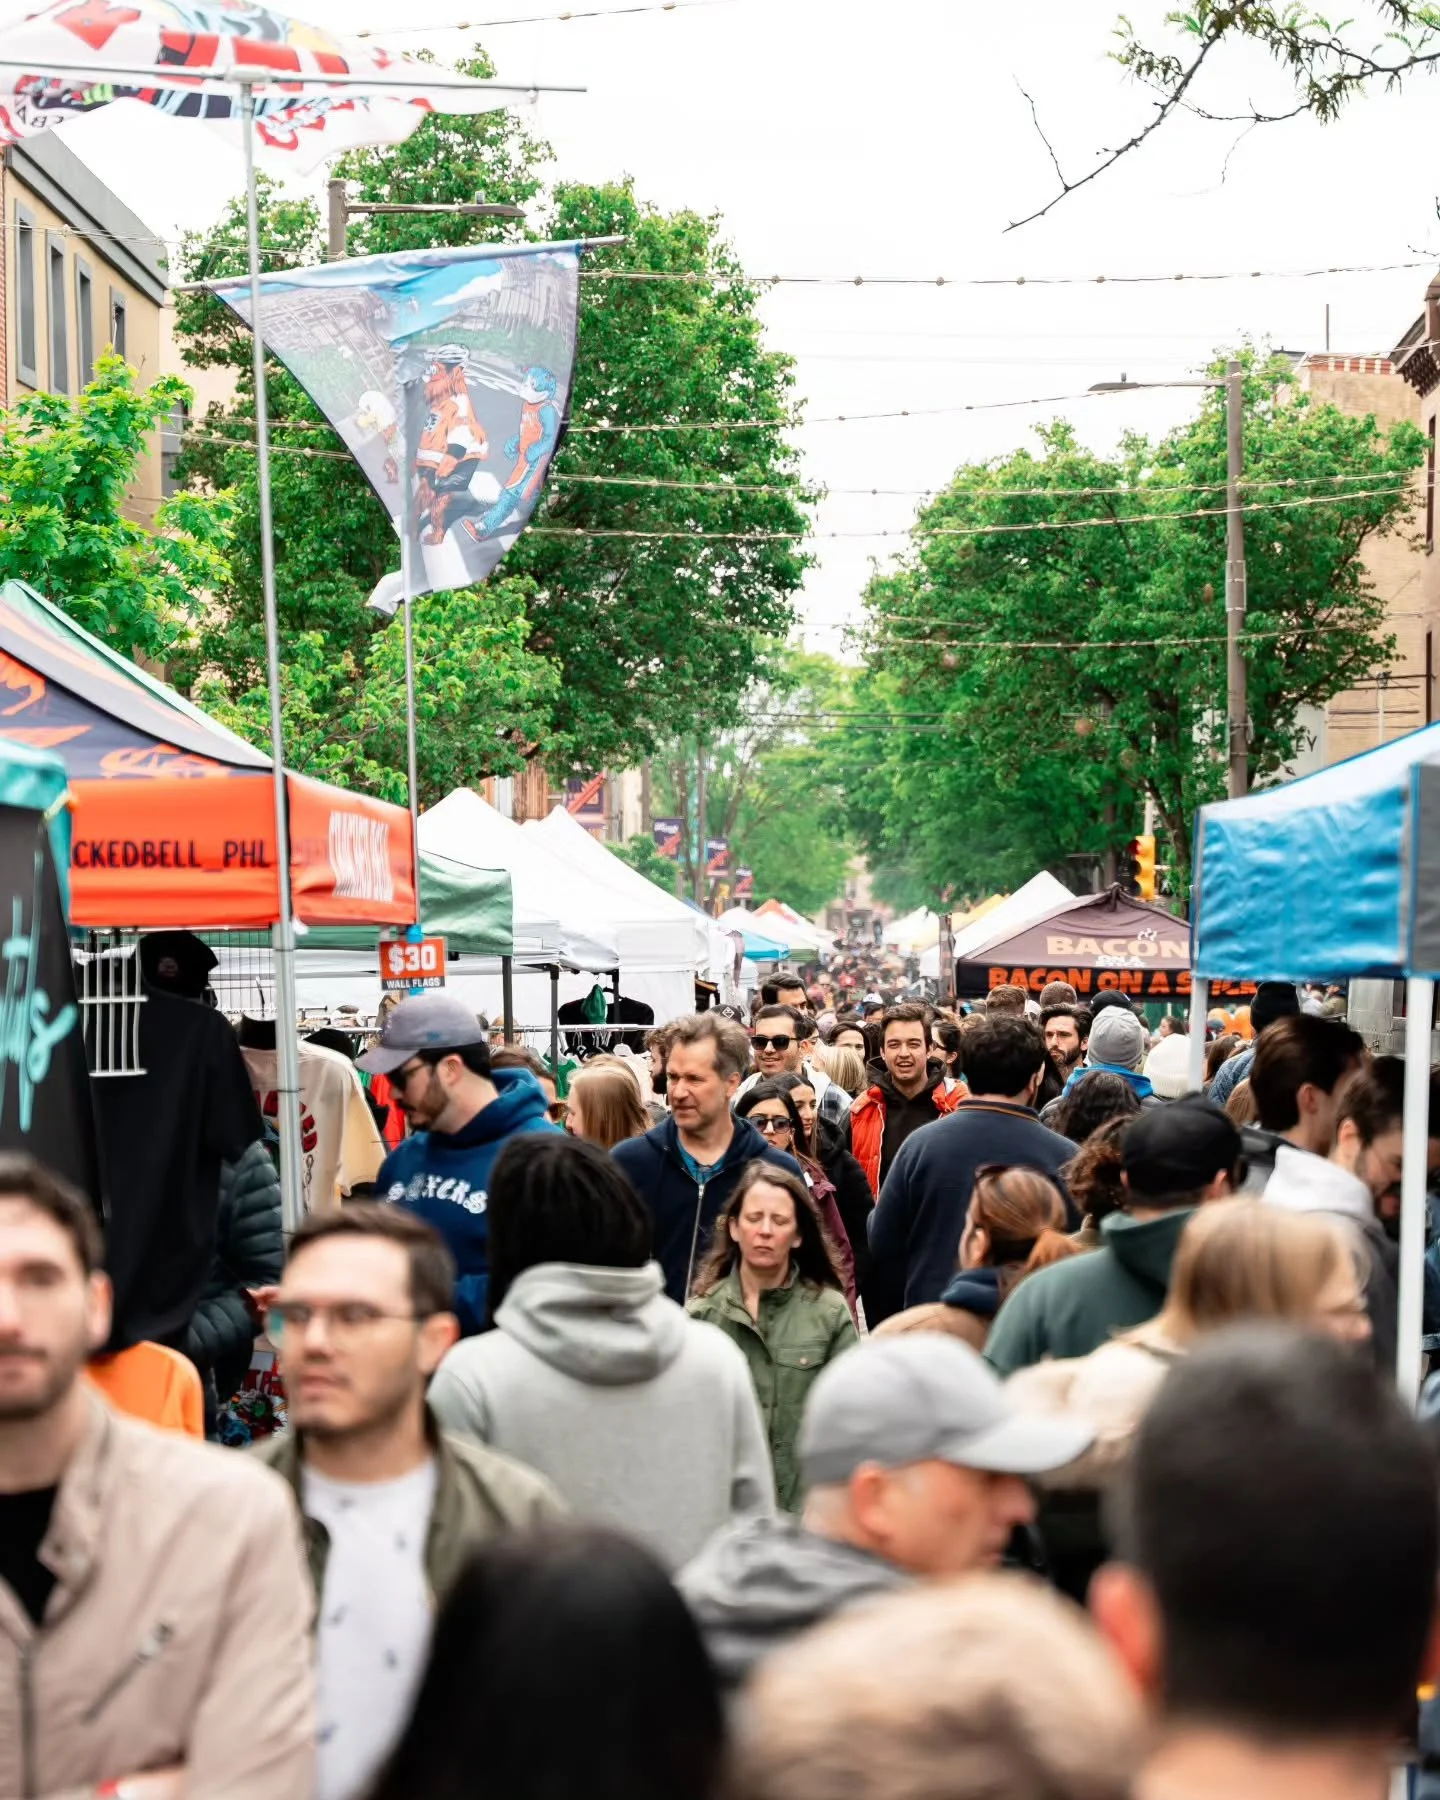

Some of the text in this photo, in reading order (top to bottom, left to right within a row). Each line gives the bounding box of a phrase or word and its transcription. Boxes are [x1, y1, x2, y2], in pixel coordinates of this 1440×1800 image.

[1046, 935, 1189, 959] BACON
[388, 944, 437, 976] $30
[386, 976, 441, 989] WALL FLAGS
[988, 967, 1092, 993] BACON
[1097, 970, 1143, 993] ON
[1147, 970, 1171, 993] A
